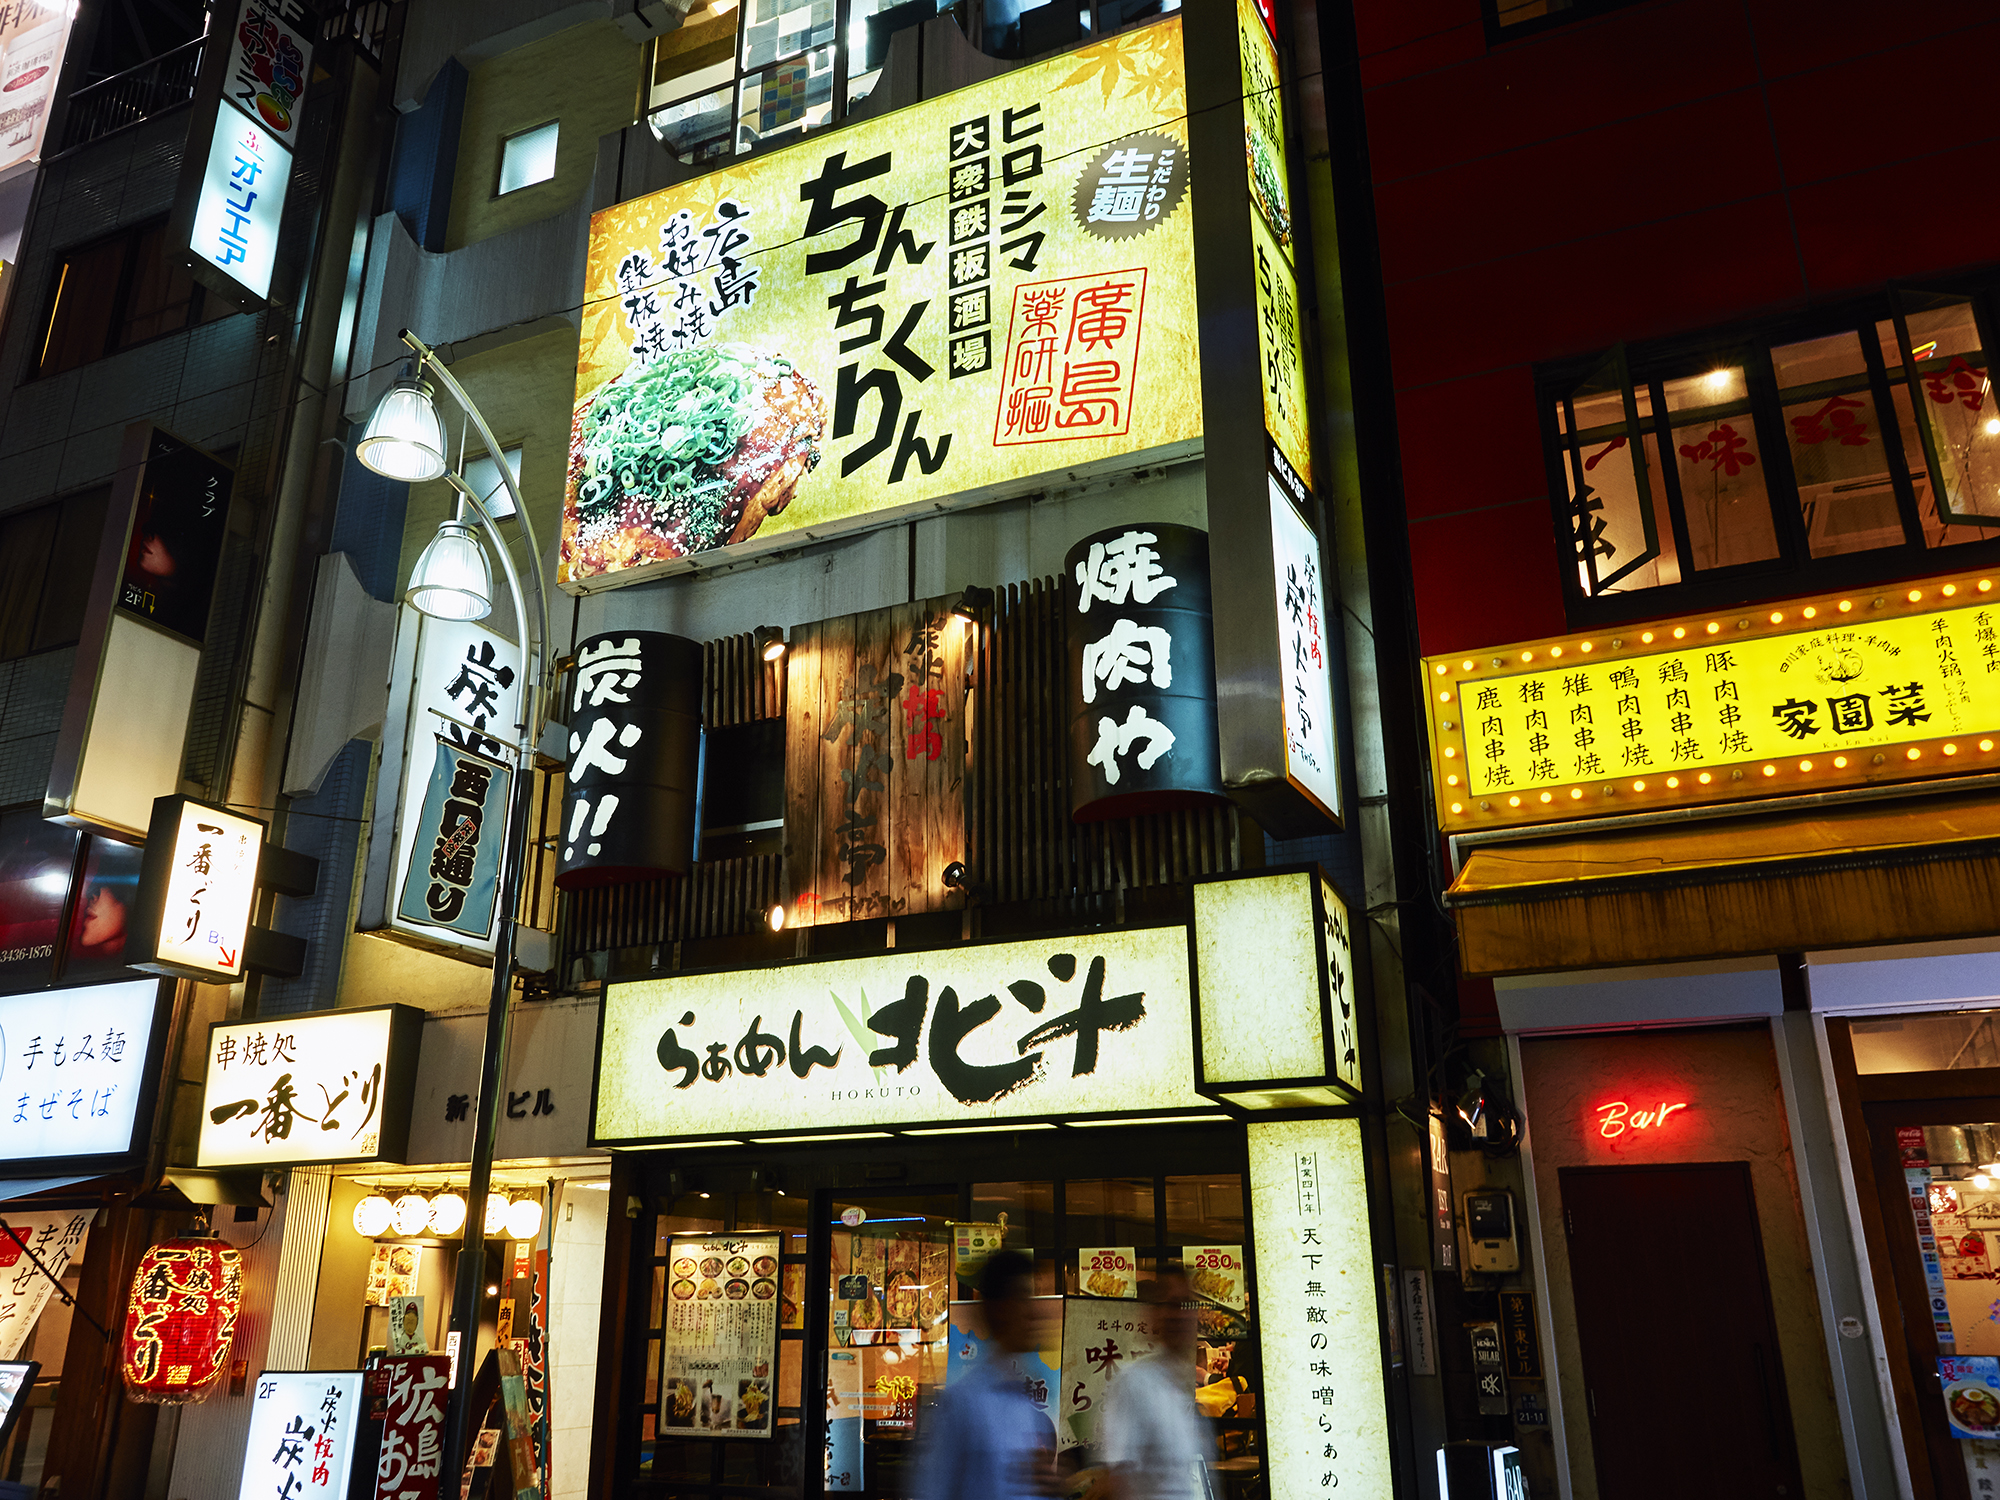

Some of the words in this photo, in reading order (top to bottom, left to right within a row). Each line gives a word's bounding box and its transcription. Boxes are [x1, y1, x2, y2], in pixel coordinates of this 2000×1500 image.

[246, 131, 263, 152] 3F
[1000, 103, 1048, 272] ヒロシマ
[1087, 148, 1154, 223] 生麺
[1144, 149, 1175, 220] こだわり
[662, 213, 712, 349] お好み焼
[703, 202, 758, 316] 広島
[952, 119, 990, 376] 大衆鉄板酒場
[619, 255, 672, 364] 鉄板焼
[800, 151, 952, 485] ちんちくりん
[1256, 243, 1287, 421] ちんちくりん
[1284, 285, 1297, 371] ヒロシマ
[1055, 280, 1135, 429] 廣島
[125, 590, 142, 605] 2F
[1075, 530, 1177, 785] 焼肉や
[1476, 686, 1514, 788] 鹿肉串焼
[1518, 680, 1559, 781] 猪肉串焼
[1609, 667, 1654, 768] 鴨肉串焼
[1704, 652, 1753, 756] 豚肉串焼
[1772, 681, 1932, 740] 家園菜
[1869, 735, 1889, 743] Sai
[426, 757, 493, 923] 西口通り
[178, 823, 224, 946] 一番どり
[208, 930, 225, 945] B1
[23, 1028, 127, 1071] 手もみ麺
[216, 1031, 297, 1071] 串焼処
[867, 953, 1146, 1107] 北斗
[12, 1083, 118, 1123] まぜそば
[210, 1063, 381, 1144] 一番どり
[445, 1088, 555, 1122] 新ビル
[830, 1086, 922, 1101] HOKUTO
[1596, 1101, 1687, 1138] Bar
[1301, 1156, 1316, 1213] 創業四十年
[134, 1249, 196, 1384] 一番どり
[176, 1247, 213, 1315] 串焼処
[1097, 1318, 1160, 1336] 北斗の定
[1478, 1350, 1500, 1362] SOLAR
[1510, 1296, 1532, 1375] 第三東ビル
[259, 1382, 277, 1399] 2F
[1519, 1411, 1544, 1422] 21-11
[312, 1385, 342, 1486] 炭火焼肉
